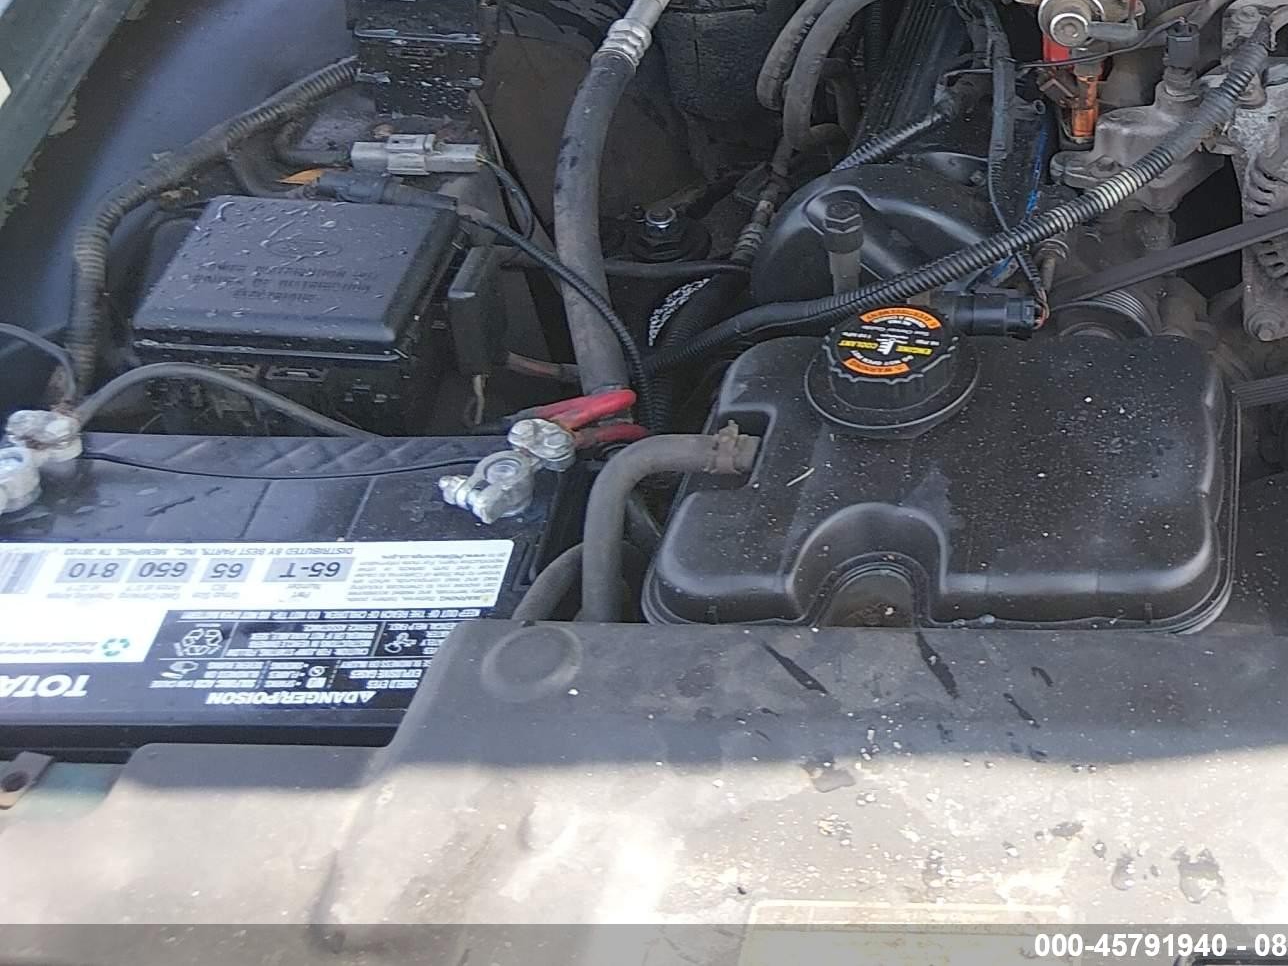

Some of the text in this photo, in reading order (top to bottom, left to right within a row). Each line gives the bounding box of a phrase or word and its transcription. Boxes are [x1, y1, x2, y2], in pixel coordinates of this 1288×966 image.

[837, 340, 879, 351] COOLANT
[284, 547, 354, 556] DISTRIBUTED
[68, 562, 120, 578] 810
[139, 561, 187, 578] 650
[211, 562, 243, 579] 65
[279, 561, 341, 579] 65-T
[205, 690, 361, 705] DANGER/POISON
